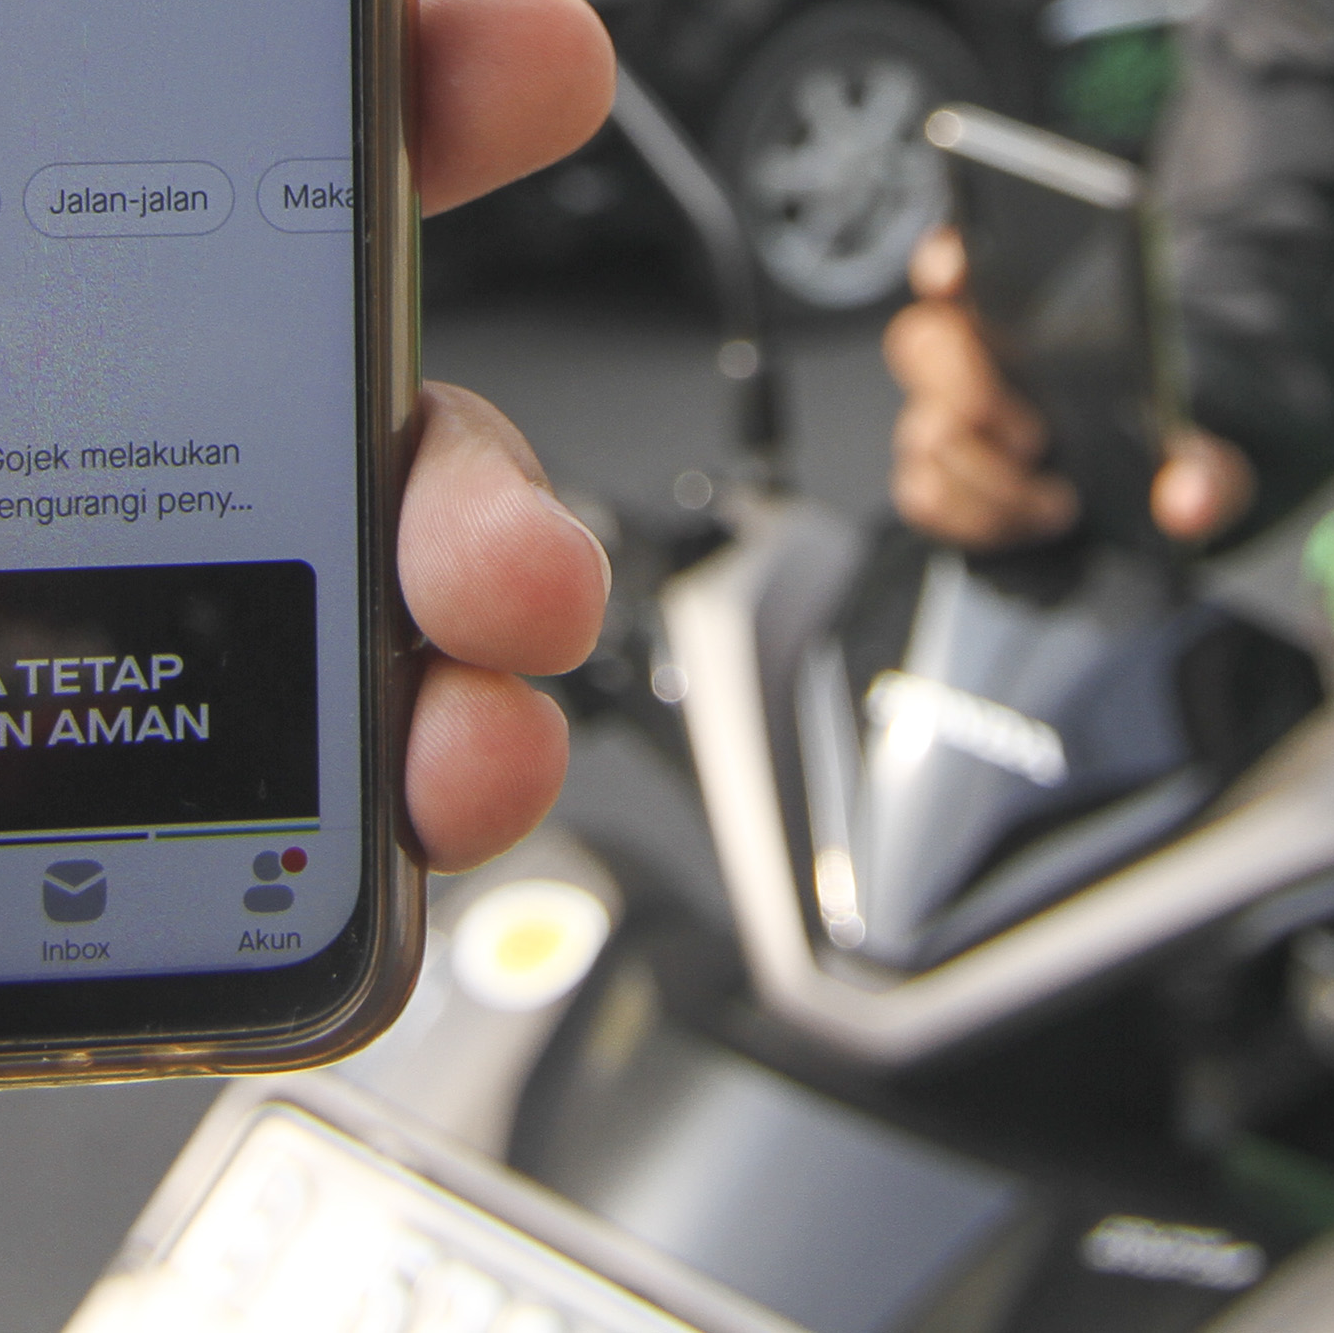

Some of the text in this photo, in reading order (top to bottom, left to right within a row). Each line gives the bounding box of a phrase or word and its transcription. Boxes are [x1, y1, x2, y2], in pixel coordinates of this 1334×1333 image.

[49, 184, 208, 219] Jalan-jalan
[80, 439, 241, 470] melakukan
[16, 654, 184, 696] TETAP
[47, 703, 210, 746] AMAN
[42, 937, 111, 963] Inbox
[238, 927, 302, 953] Akun
